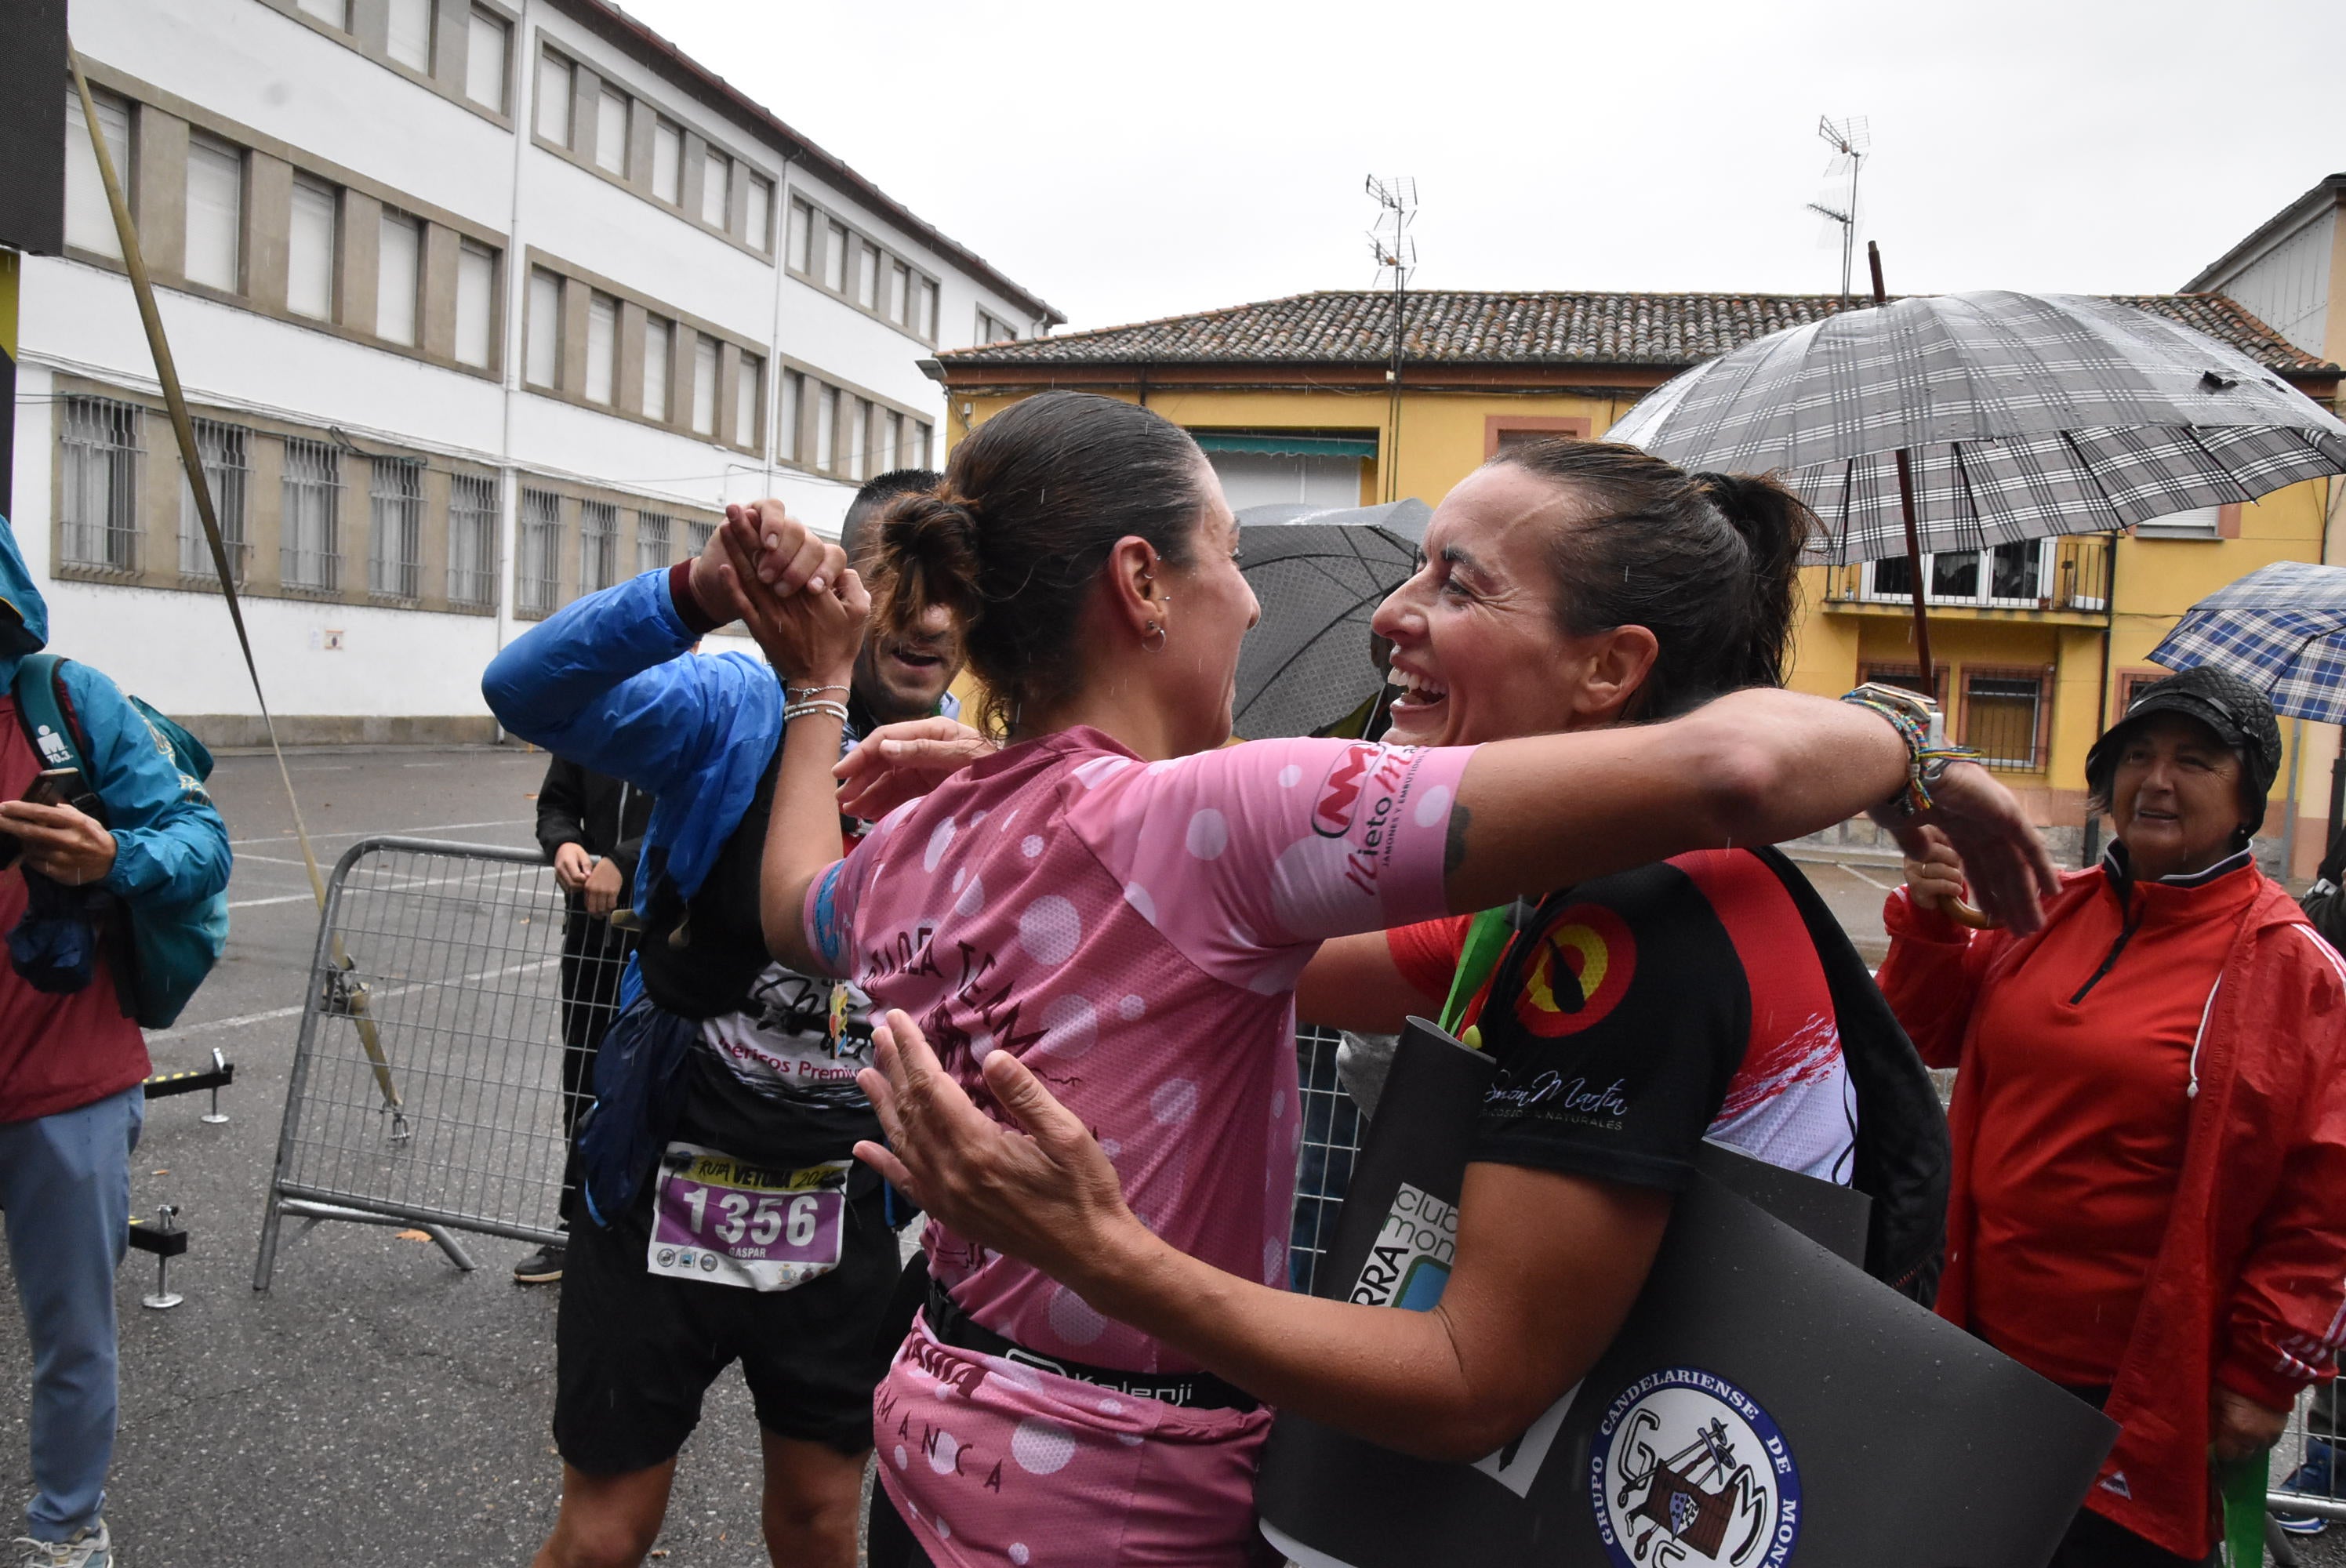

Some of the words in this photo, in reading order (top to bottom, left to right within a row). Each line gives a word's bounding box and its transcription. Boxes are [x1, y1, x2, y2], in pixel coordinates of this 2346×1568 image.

[798, 1060, 863, 1080] Premiu
[1545, 1111, 1622, 1131] NATURALES
[683, 1187, 819, 1247] 1356
[1381, 1212, 1456, 1263] mon
[728, 1247, 766, 1259] GASPAR
[1075, 1372, 1193, 1407] Klenji
[1600, 1369, 1760, 1436] CANDELARIENSE
[1765, 1436, 1792, 1475] DE
[1592, 1456, 1614, 1545] GRUPO
[1763, 1498, 1797, 1568] MON
